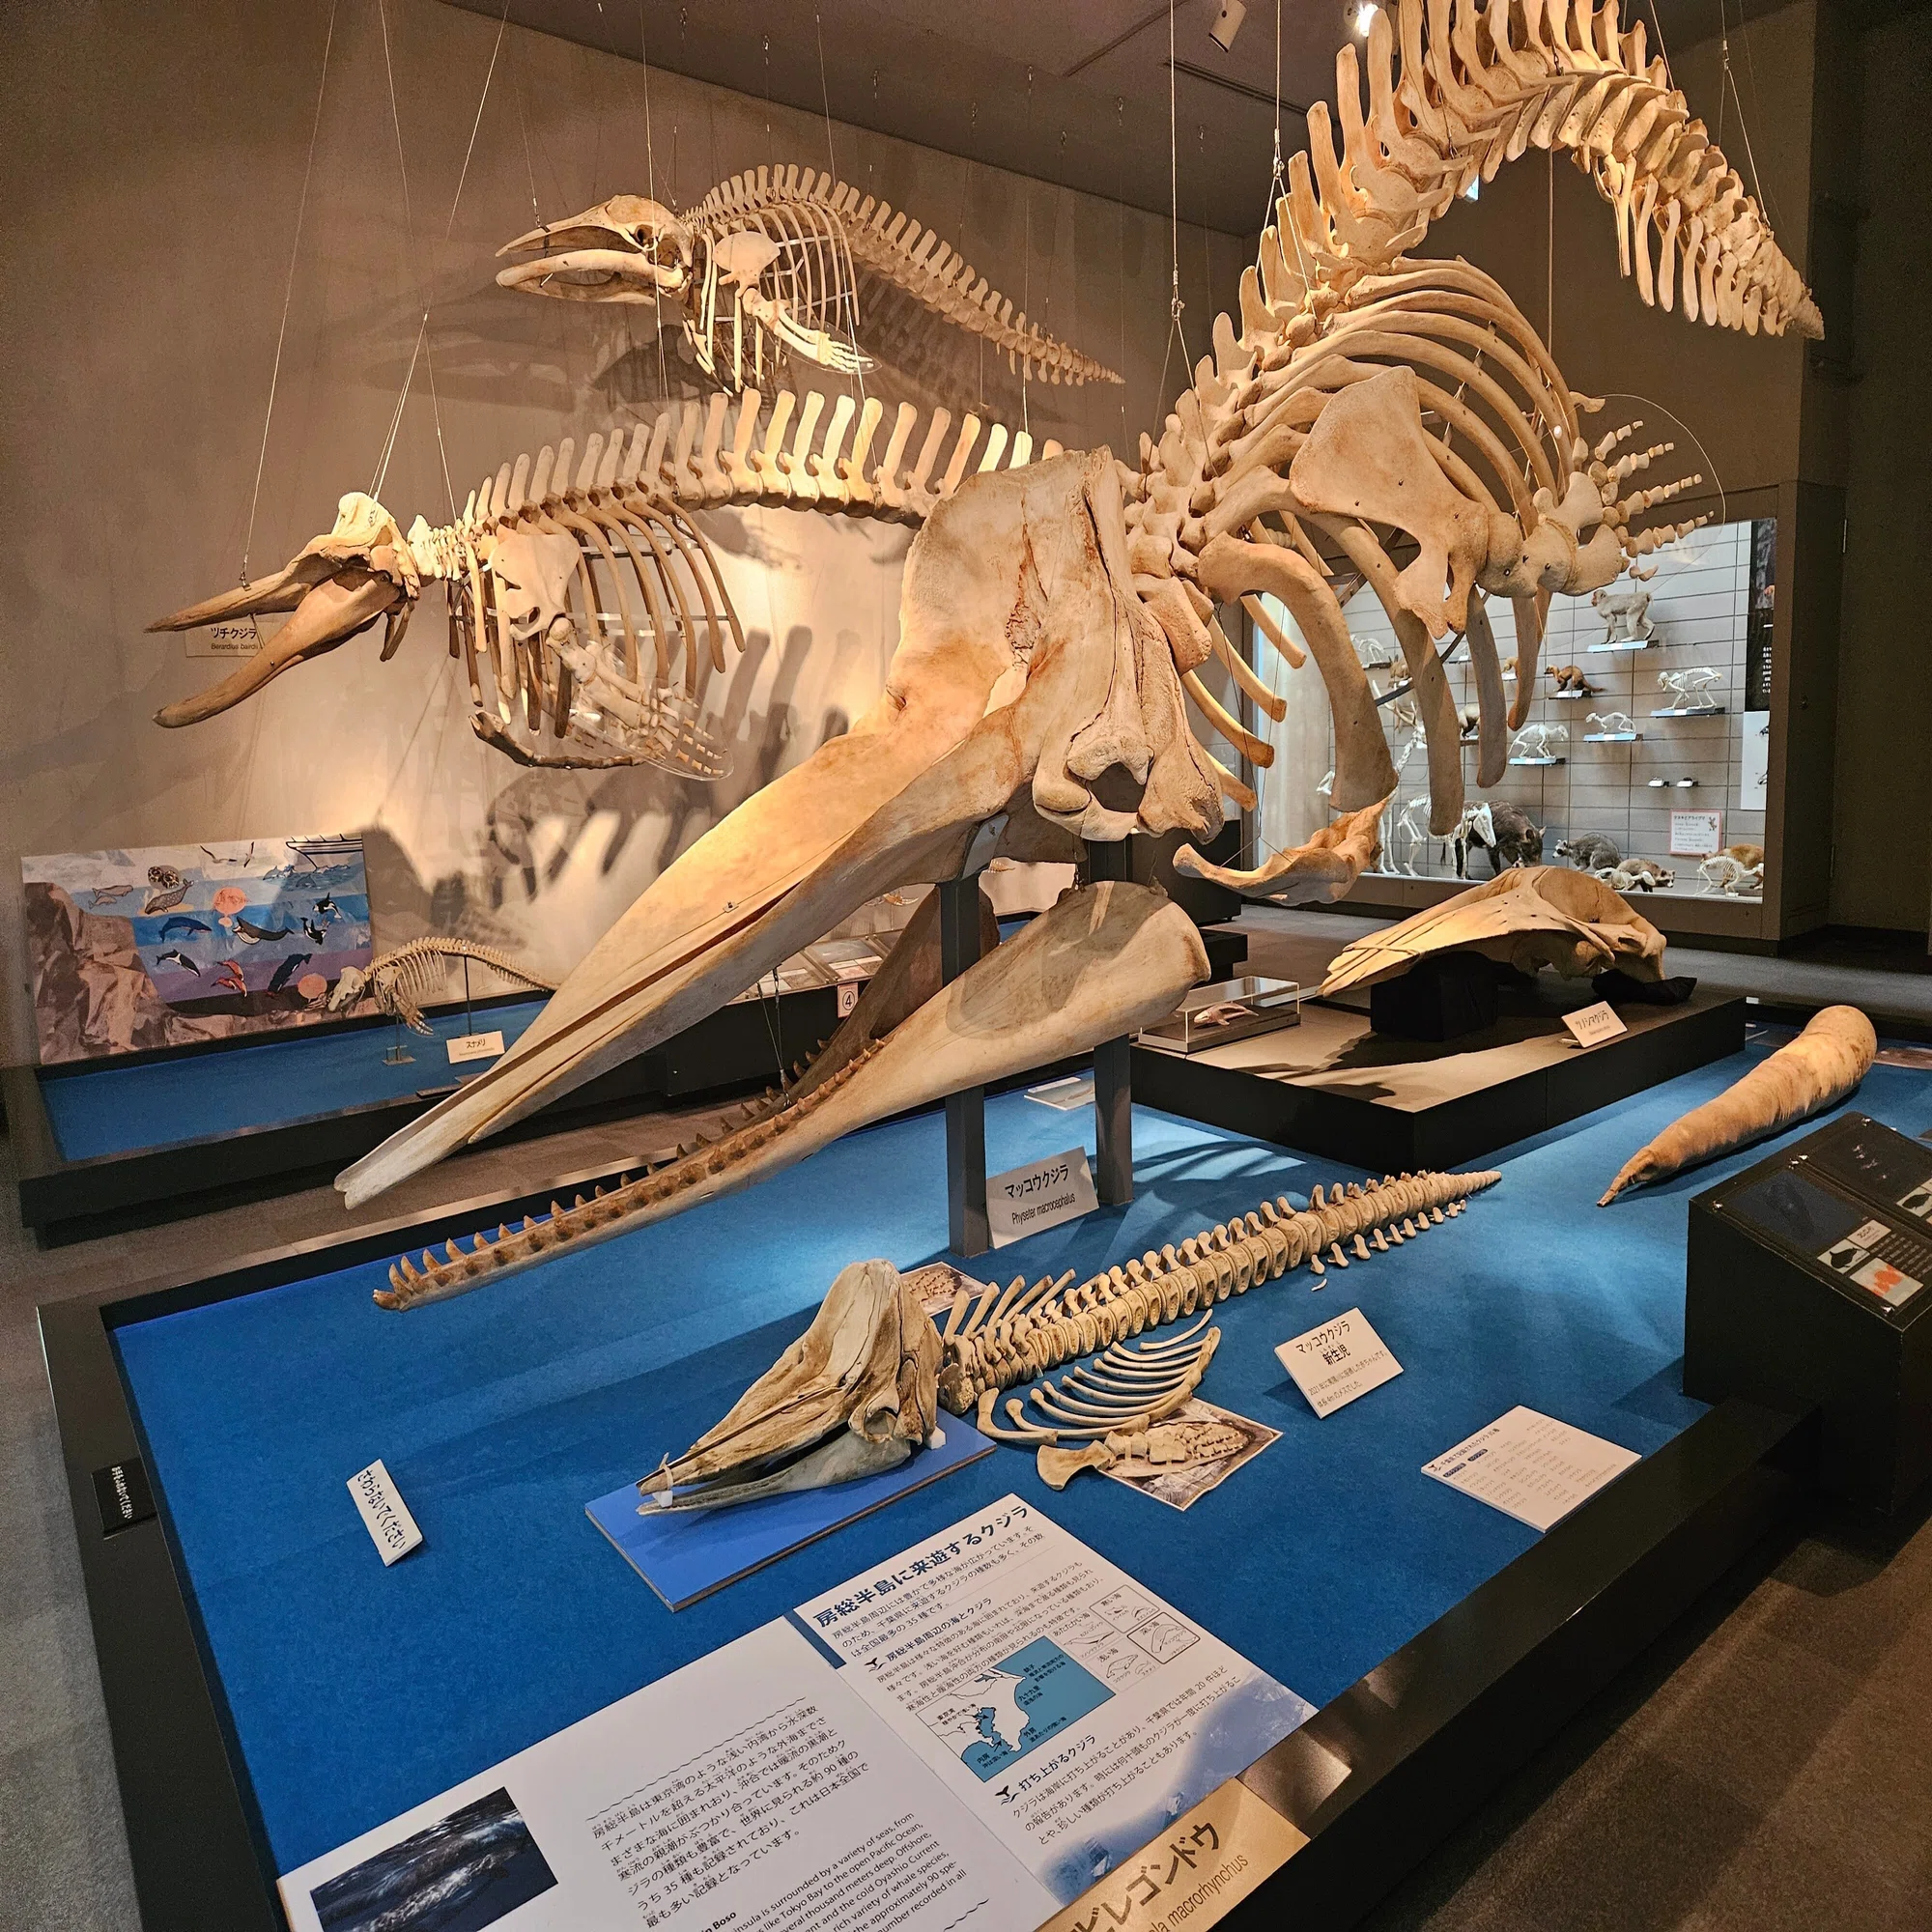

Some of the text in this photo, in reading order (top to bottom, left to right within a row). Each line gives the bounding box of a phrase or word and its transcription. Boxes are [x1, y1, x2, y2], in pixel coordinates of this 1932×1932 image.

[211, 627, 257, 639] ツチクジラ
[1005, 1164, 1069, 1199] マッコウクジラ
[1011, 1192, 1076, 1225] Physeter macrocephalus
[1295, 1320, 1350, 1354] マッコウクジラ
[1322, 1344, 1350, 1365] 新生児
[357, 1469, 406, 1548] さわらないでください
[812, 1504, 1027, 1628] 房総半島に来遊するクジラ
[885, 1598, 991, 1662] 房総半島周辺の海とクジラ
[1018, 1732, 1099, 1791] 打ち上がるクジラ
[644, 1830, 799, 1928] 最も多い記録となっています。
[761, 1914, 781, 1930] like
[778, 1895, 810, 1918] Tokyo
[804, 1888, 825, 1903] Bay
[833, 1870, 849, 1883] the
[846, 1856, 872, 1876] open
[867, 1837, 896, 1859] Pacific
[893, 1819, 924, 1843] Ocean,
[768, 1874, 819, 1911] surrounded
[818, 1867, 831, 1877] by
[838, 1842, 867, 1864] variety
[863, 1835, 877, 1847] of
[874, 1824, 897, 1841] seas,
[892, 1810, 915, 1828] from
[802, 1887, 846, 1918] thousand
[843, 1868, 875, 1891] meters
[895, 1828, 933, 1859] Offshore,
[821, 1907, 838, 1924] and
[837, 1895, 855, 1912] the
[852, 1884, 875, 1900] cold
[875, 1859, 911, 1889] Oyashio
[905, 1837, 940, 1864] Current
[832, 1849, 949, 1932] rich variety of whale species,
[866, 1878, 931, 1926] approximately
[924, 1870, 940, 1883] 90
[937, 1861, 960, 1877] spe-
[907, 1881, 948, 1913] recorded
[943, 1875, 956, 1887] in
[952, 1866, 968, 1880] all
[1070, 1822, 1219, 1932] ビレゴンドウ
[1167, 1854, 1249, 1927] macrorhynchus
[711, 1909, 738, 1930] Boso
